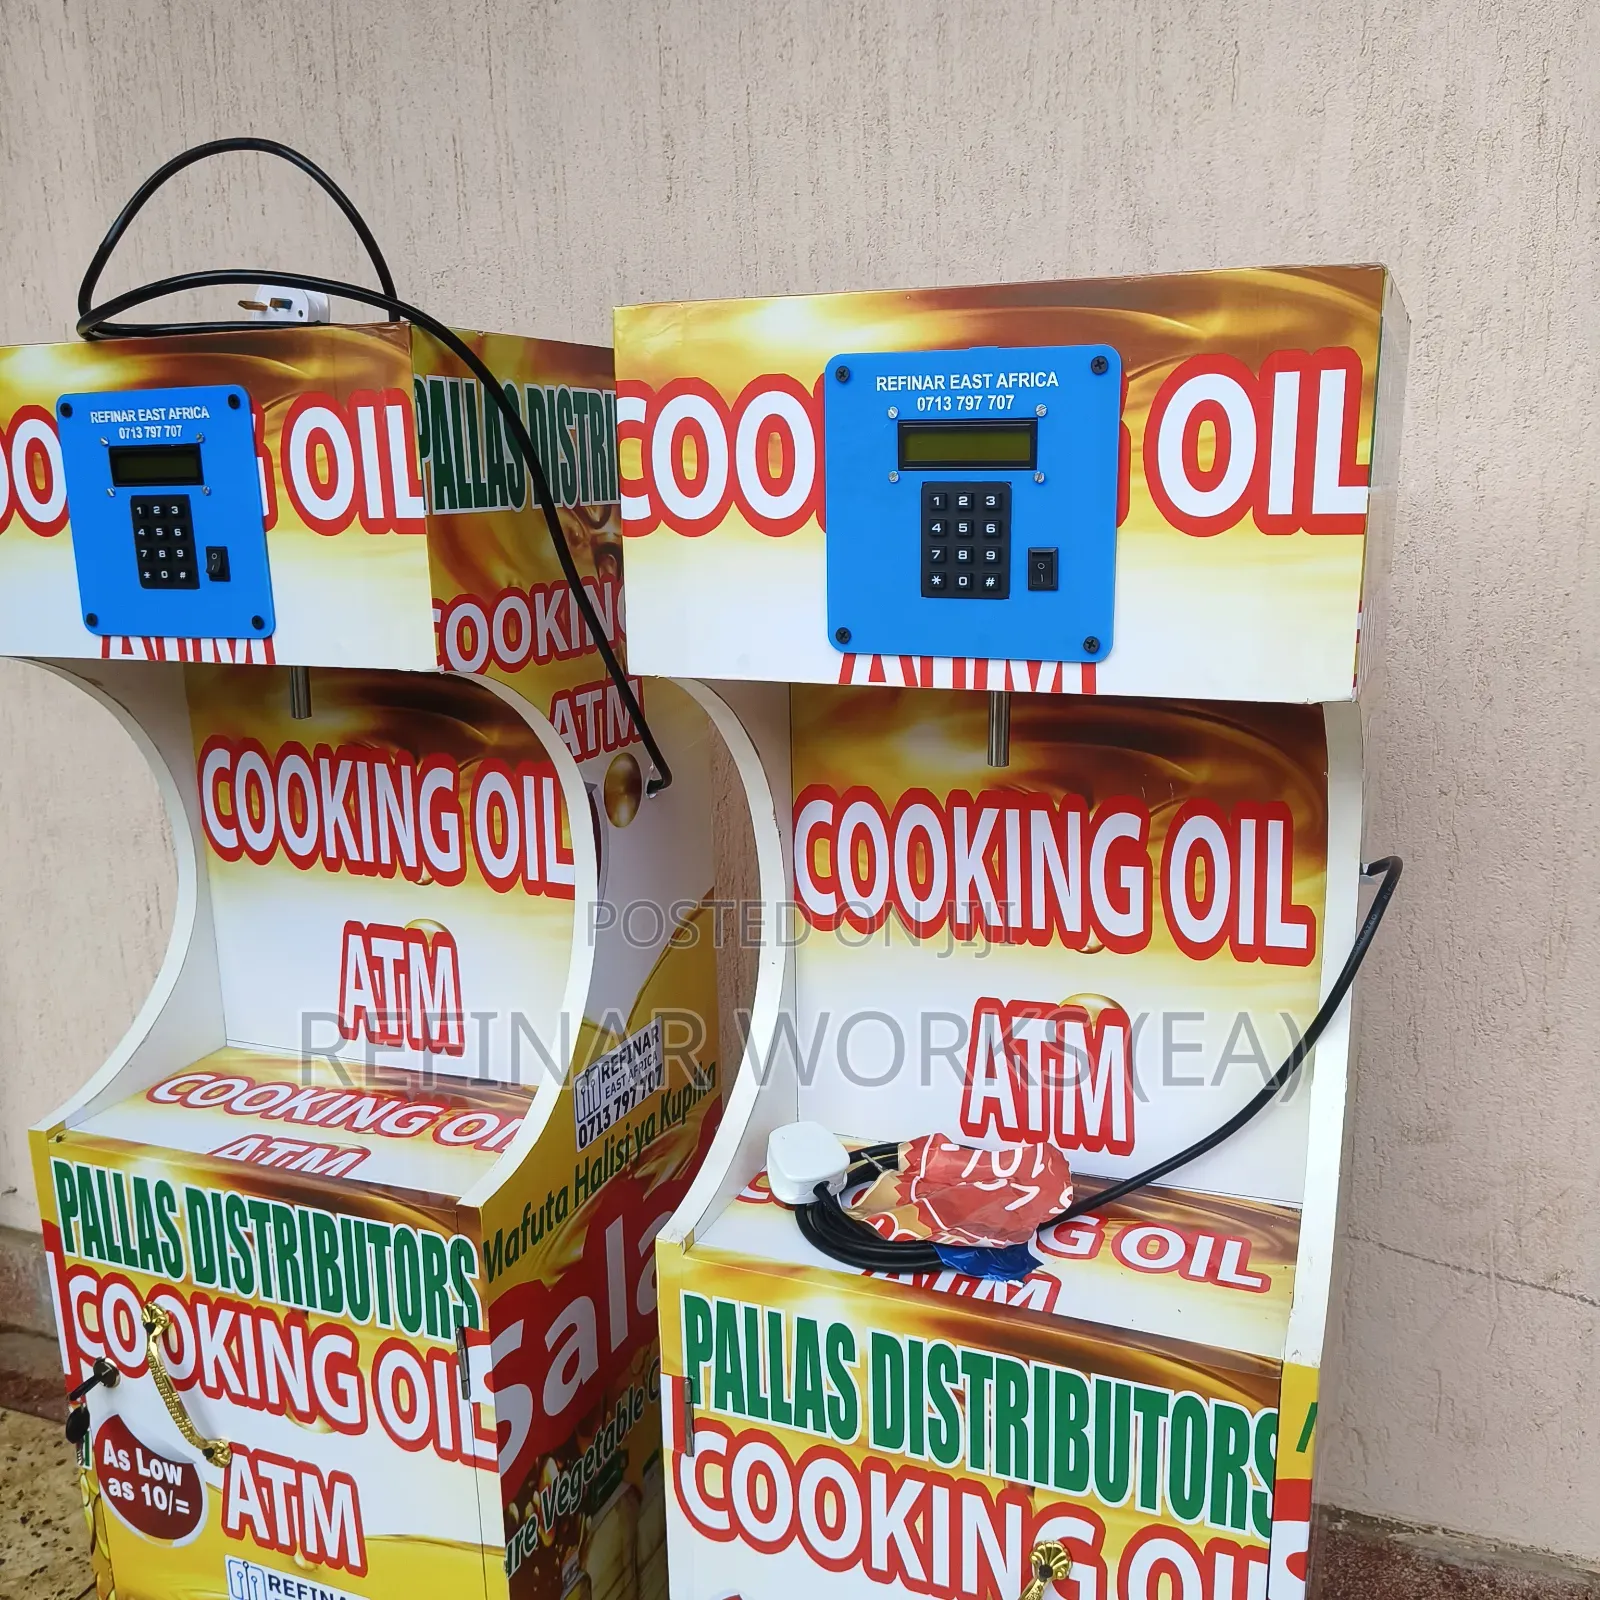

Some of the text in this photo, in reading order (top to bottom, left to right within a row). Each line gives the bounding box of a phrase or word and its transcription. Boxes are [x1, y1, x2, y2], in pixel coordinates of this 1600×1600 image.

[875, 371, 1060, 392] REFINAR EAST AFRICA
[916, 394, 1015, 412] 0713 797 707
[89, 405, 211, 424] REFINAR EAST AFRICA
[118, 424, 183, 440] 0713 797 707
[1153, 366, 1368, 522] OIL
[287, 403, 428, 522] OIL
[136, 505, 179, 515] 1 2 3
[137, 527, 182, 537] 4 5 6
[931, 523, 996, 533] 4 5 6
[932, 496, 996, 506] 1 2 3
[140, 549, 184, 558] 7 8 9
[160, 570, 169, 579] 0
[931, 550, 996, 561] 7 8 9
[958, 576, 968, 586] 0
[552, 678, 641, 759] ATM
[202, 745, 576, 888] COOKING OIL
[792, 797, 1312, 952] COOKING OIL
[342, 929, 463, 1050] ATM
[601, 1024, 660, 1084] REFINAR
[604, 1050, 659, 1100] EAST AFRICA
[965, 1008, 1134, 1144] ATM
[153, 1072, 441, 1137] COOKING
[577, 1062, 663, 1150] 0713 797 707
[215, 1136, 366, 1177] ATM
[482, 1060, 717, 1285] Mafuta Halisi ya Kupika
[52, 1157, 483, 1342] PALLAS DISTRIBUTORS
[1120, 1225, 1267, 1289] OIL
[67, 1269, 500, 1466] COOKING OIL
[682, 1292, 1279, 1543] PALLAS DISTRIBUTORS
[103, 1438, 131, 1473] As
[540, 1380, 646, 1534] Vegetable
[107, 1474, 192, 1518] as 10/=
[223, 1447, 366, 1574] ATM
[676, 1428, 1100, 1600] COOKING
